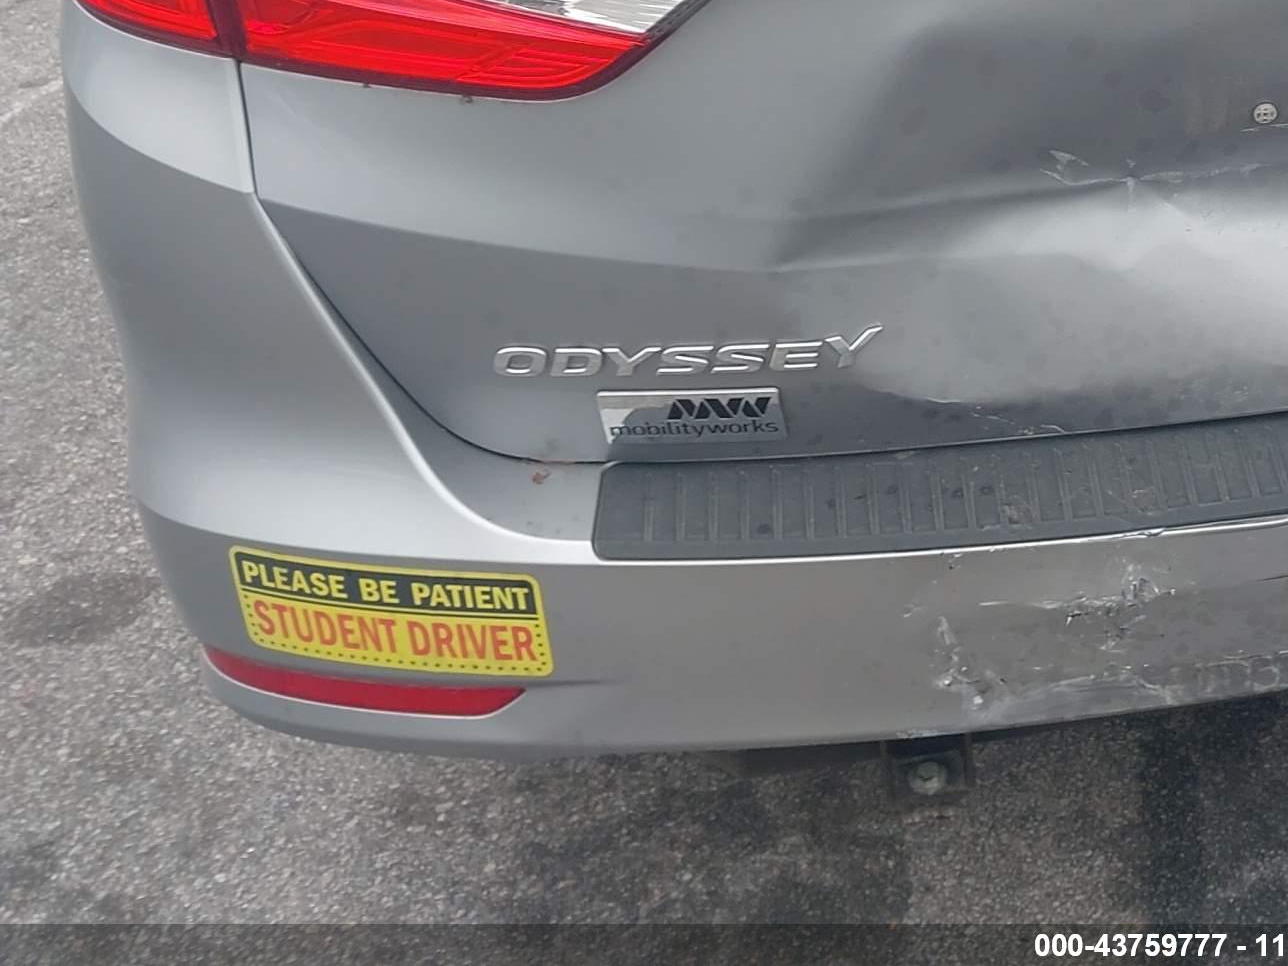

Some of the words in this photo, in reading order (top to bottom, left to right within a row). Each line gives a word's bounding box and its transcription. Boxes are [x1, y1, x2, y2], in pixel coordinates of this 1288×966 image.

[493, 322, 884, 378] ODYSSEY
[609, 418, 780, 438] mobilityworks
[241, 559, 348, 600] PLEASE
[358, 577, 400, 605] BE
[410, 581, 530, 611] PATIENT
[253, 599, 398, 655] STUDENT
[408, 620, 539, 662] DRIVER
